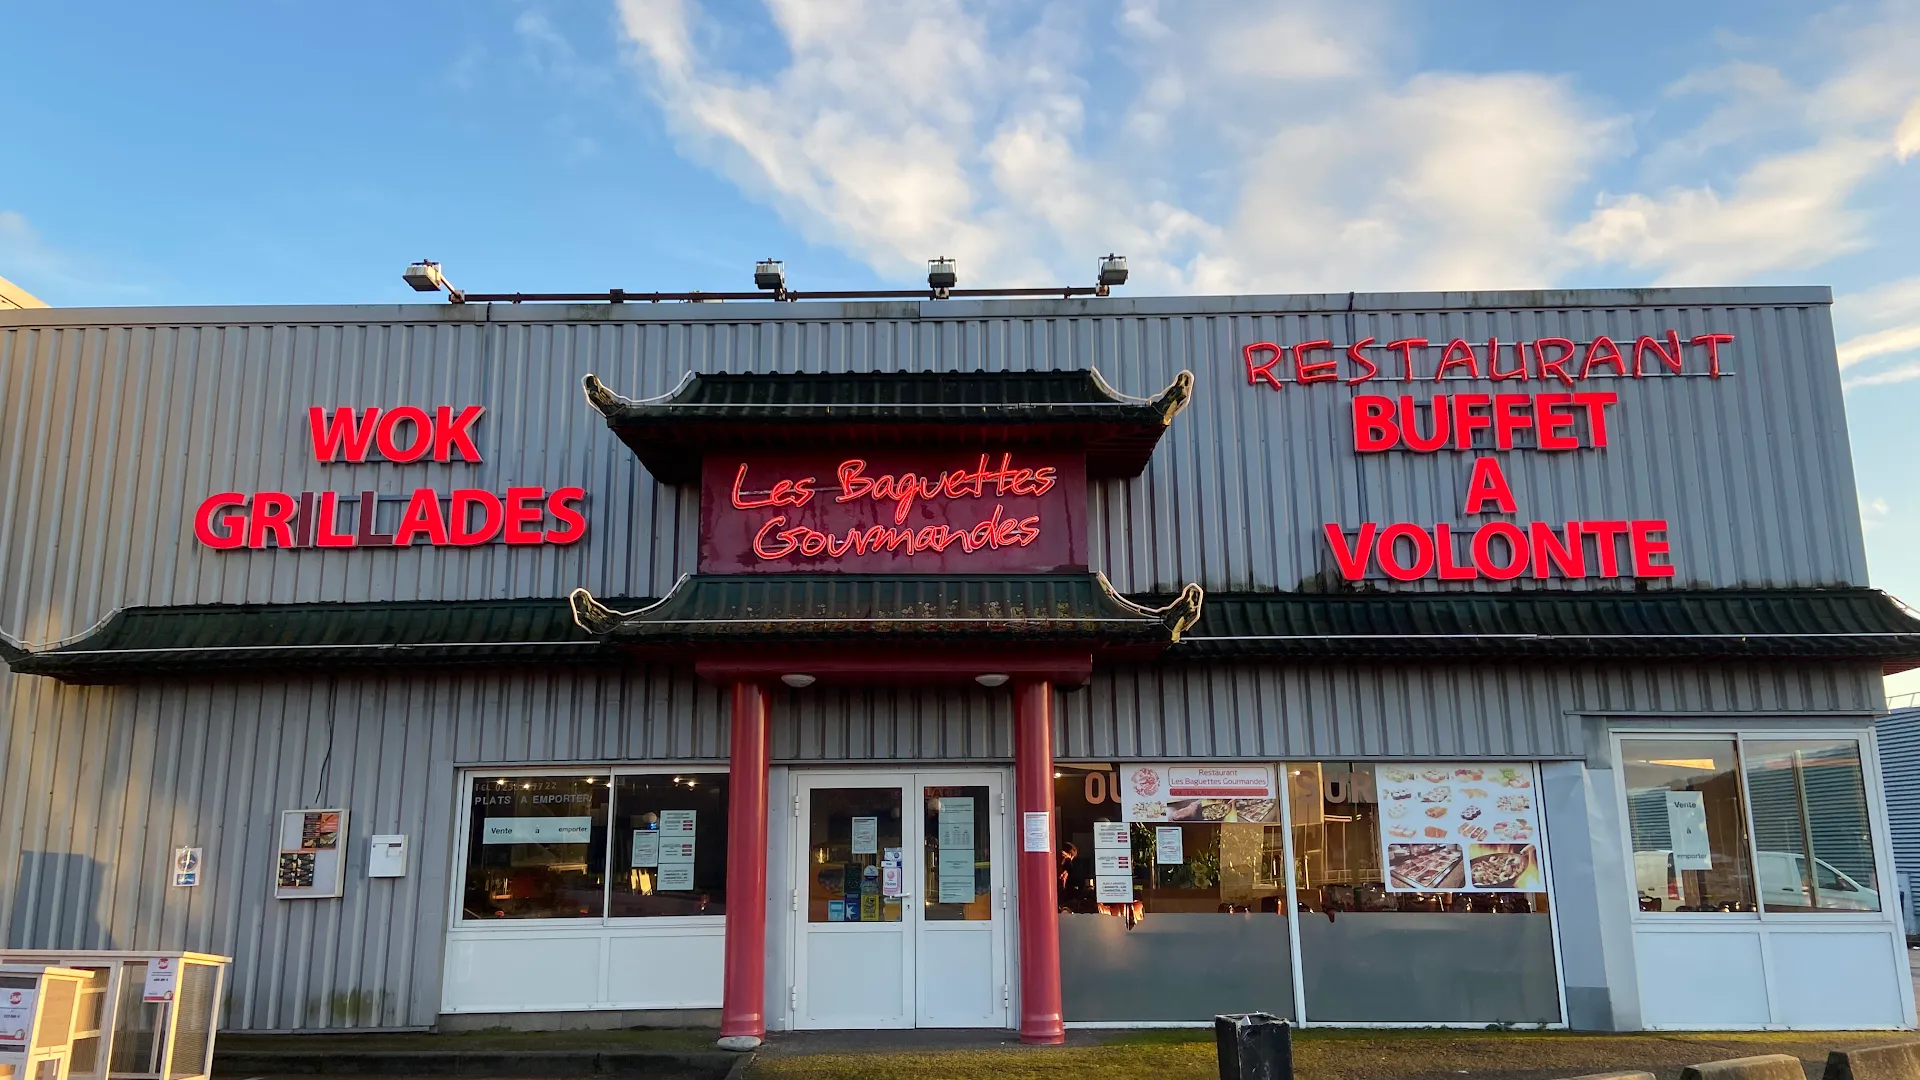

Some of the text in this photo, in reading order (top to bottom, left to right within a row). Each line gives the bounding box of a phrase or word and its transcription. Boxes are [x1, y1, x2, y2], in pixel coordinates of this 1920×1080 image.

[1242, 329, 1735, 390] RESTAURANT
[308, 406, 485, 464] WOK
[1352, 392, 1618, 453] BUFFET
[731, 452, 1057, 524] Les Baguettes
[1465, 457, 1519, 515] A
[194, 486, 589, 550] GRILLADES
[752, 505, 1041, 560] Gourmandes
[1323, 519, 1676, 581] VOLONTE
[474, 795, 512, 806] PLATS
[532, 794, 590, 804] EMPORTER
[1185, 777, 1222, 787] Baguettes
[1223, 777, 1267, 786] Gourmandes
[1198, 769, 1238, 777] Restaurant
[491, 825, 588, 835] Vente à emporter
[1674, 801, 1697, 809] Vente
